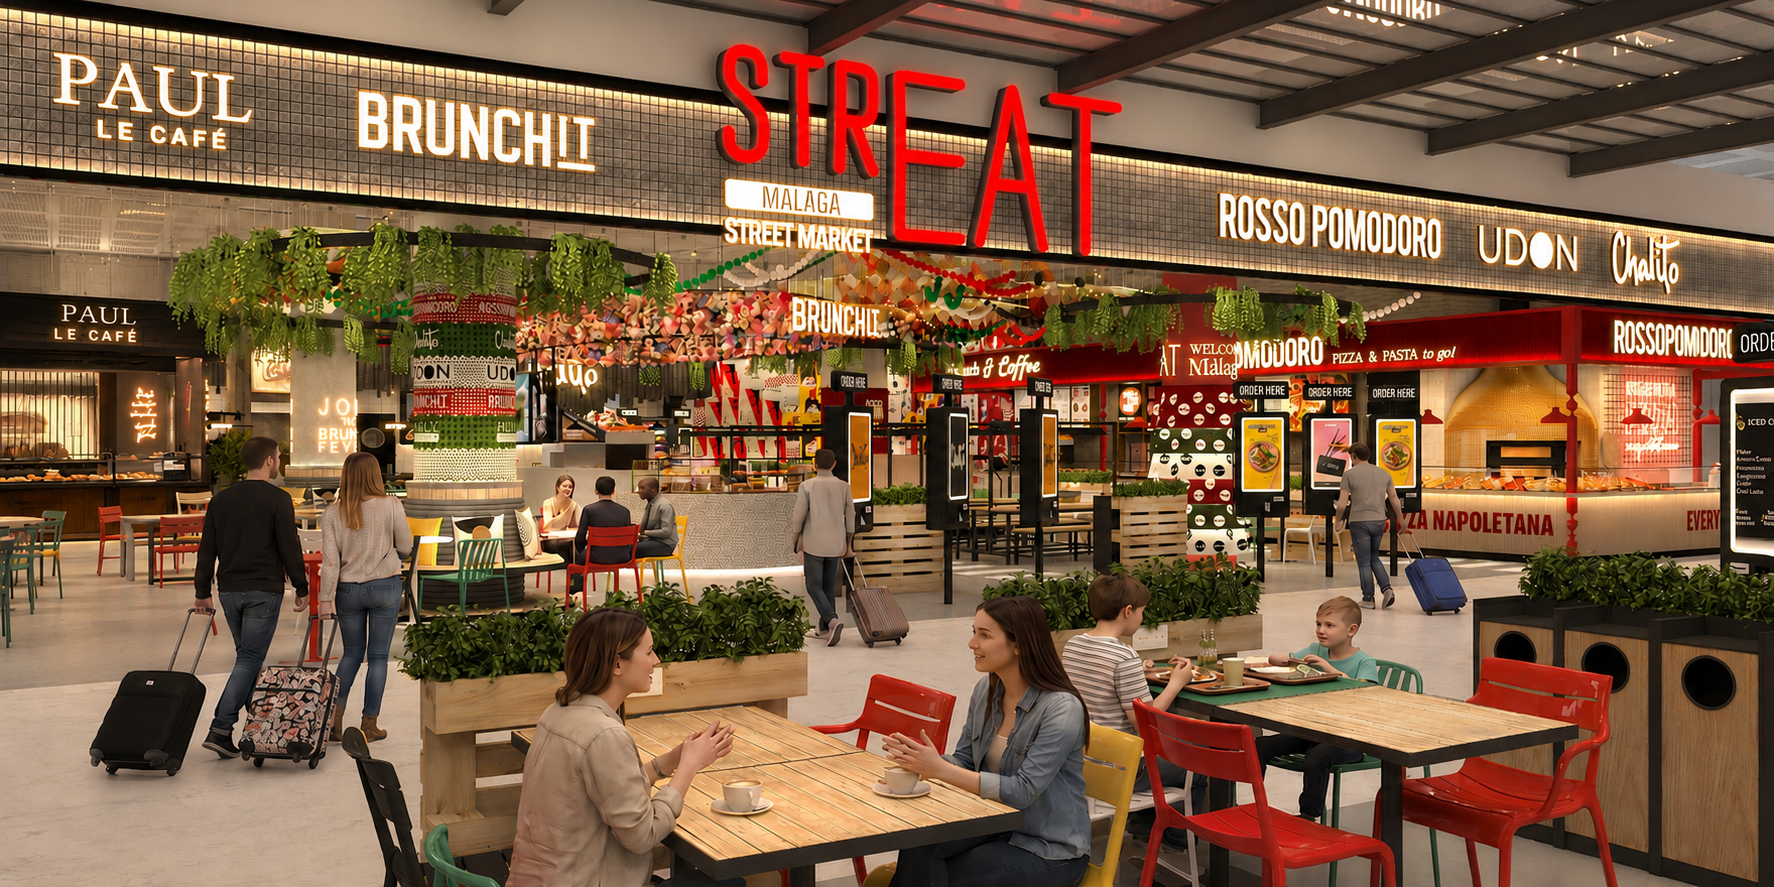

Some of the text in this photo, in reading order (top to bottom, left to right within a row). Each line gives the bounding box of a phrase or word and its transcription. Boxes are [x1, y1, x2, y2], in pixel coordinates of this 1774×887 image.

[52, 52, 252, 123] PAUL
[97, 119, 227, 150] LE CAFÉ
[716, 44, 1122, 257] STREAT
[762, 186, 841, 216] MALAGA
[724, 218, 874, 253] STREET MARKET
[1218, 192, 1441, 260] ROSSO POMODORO
[1477, 225, 1577, 272] UDON
[1610, 230, 1681, 293] Chalito
[61, 304, 137, 326] PAUL
[54, 327, 137, 343] LE CAFÉ
[998, 354, 1041, 382] Coffee
[1332, 346, 1456, 364] PIZZA & PASTA to go!
[1239, 384, 1286, 396] ORDER HERE
[1308, 387, 1353, 398] ORDER HERE
[1372, 388, 1416, 399] ORDER HERE
[1433, 510, 1554, 536] NAPOLETANA
